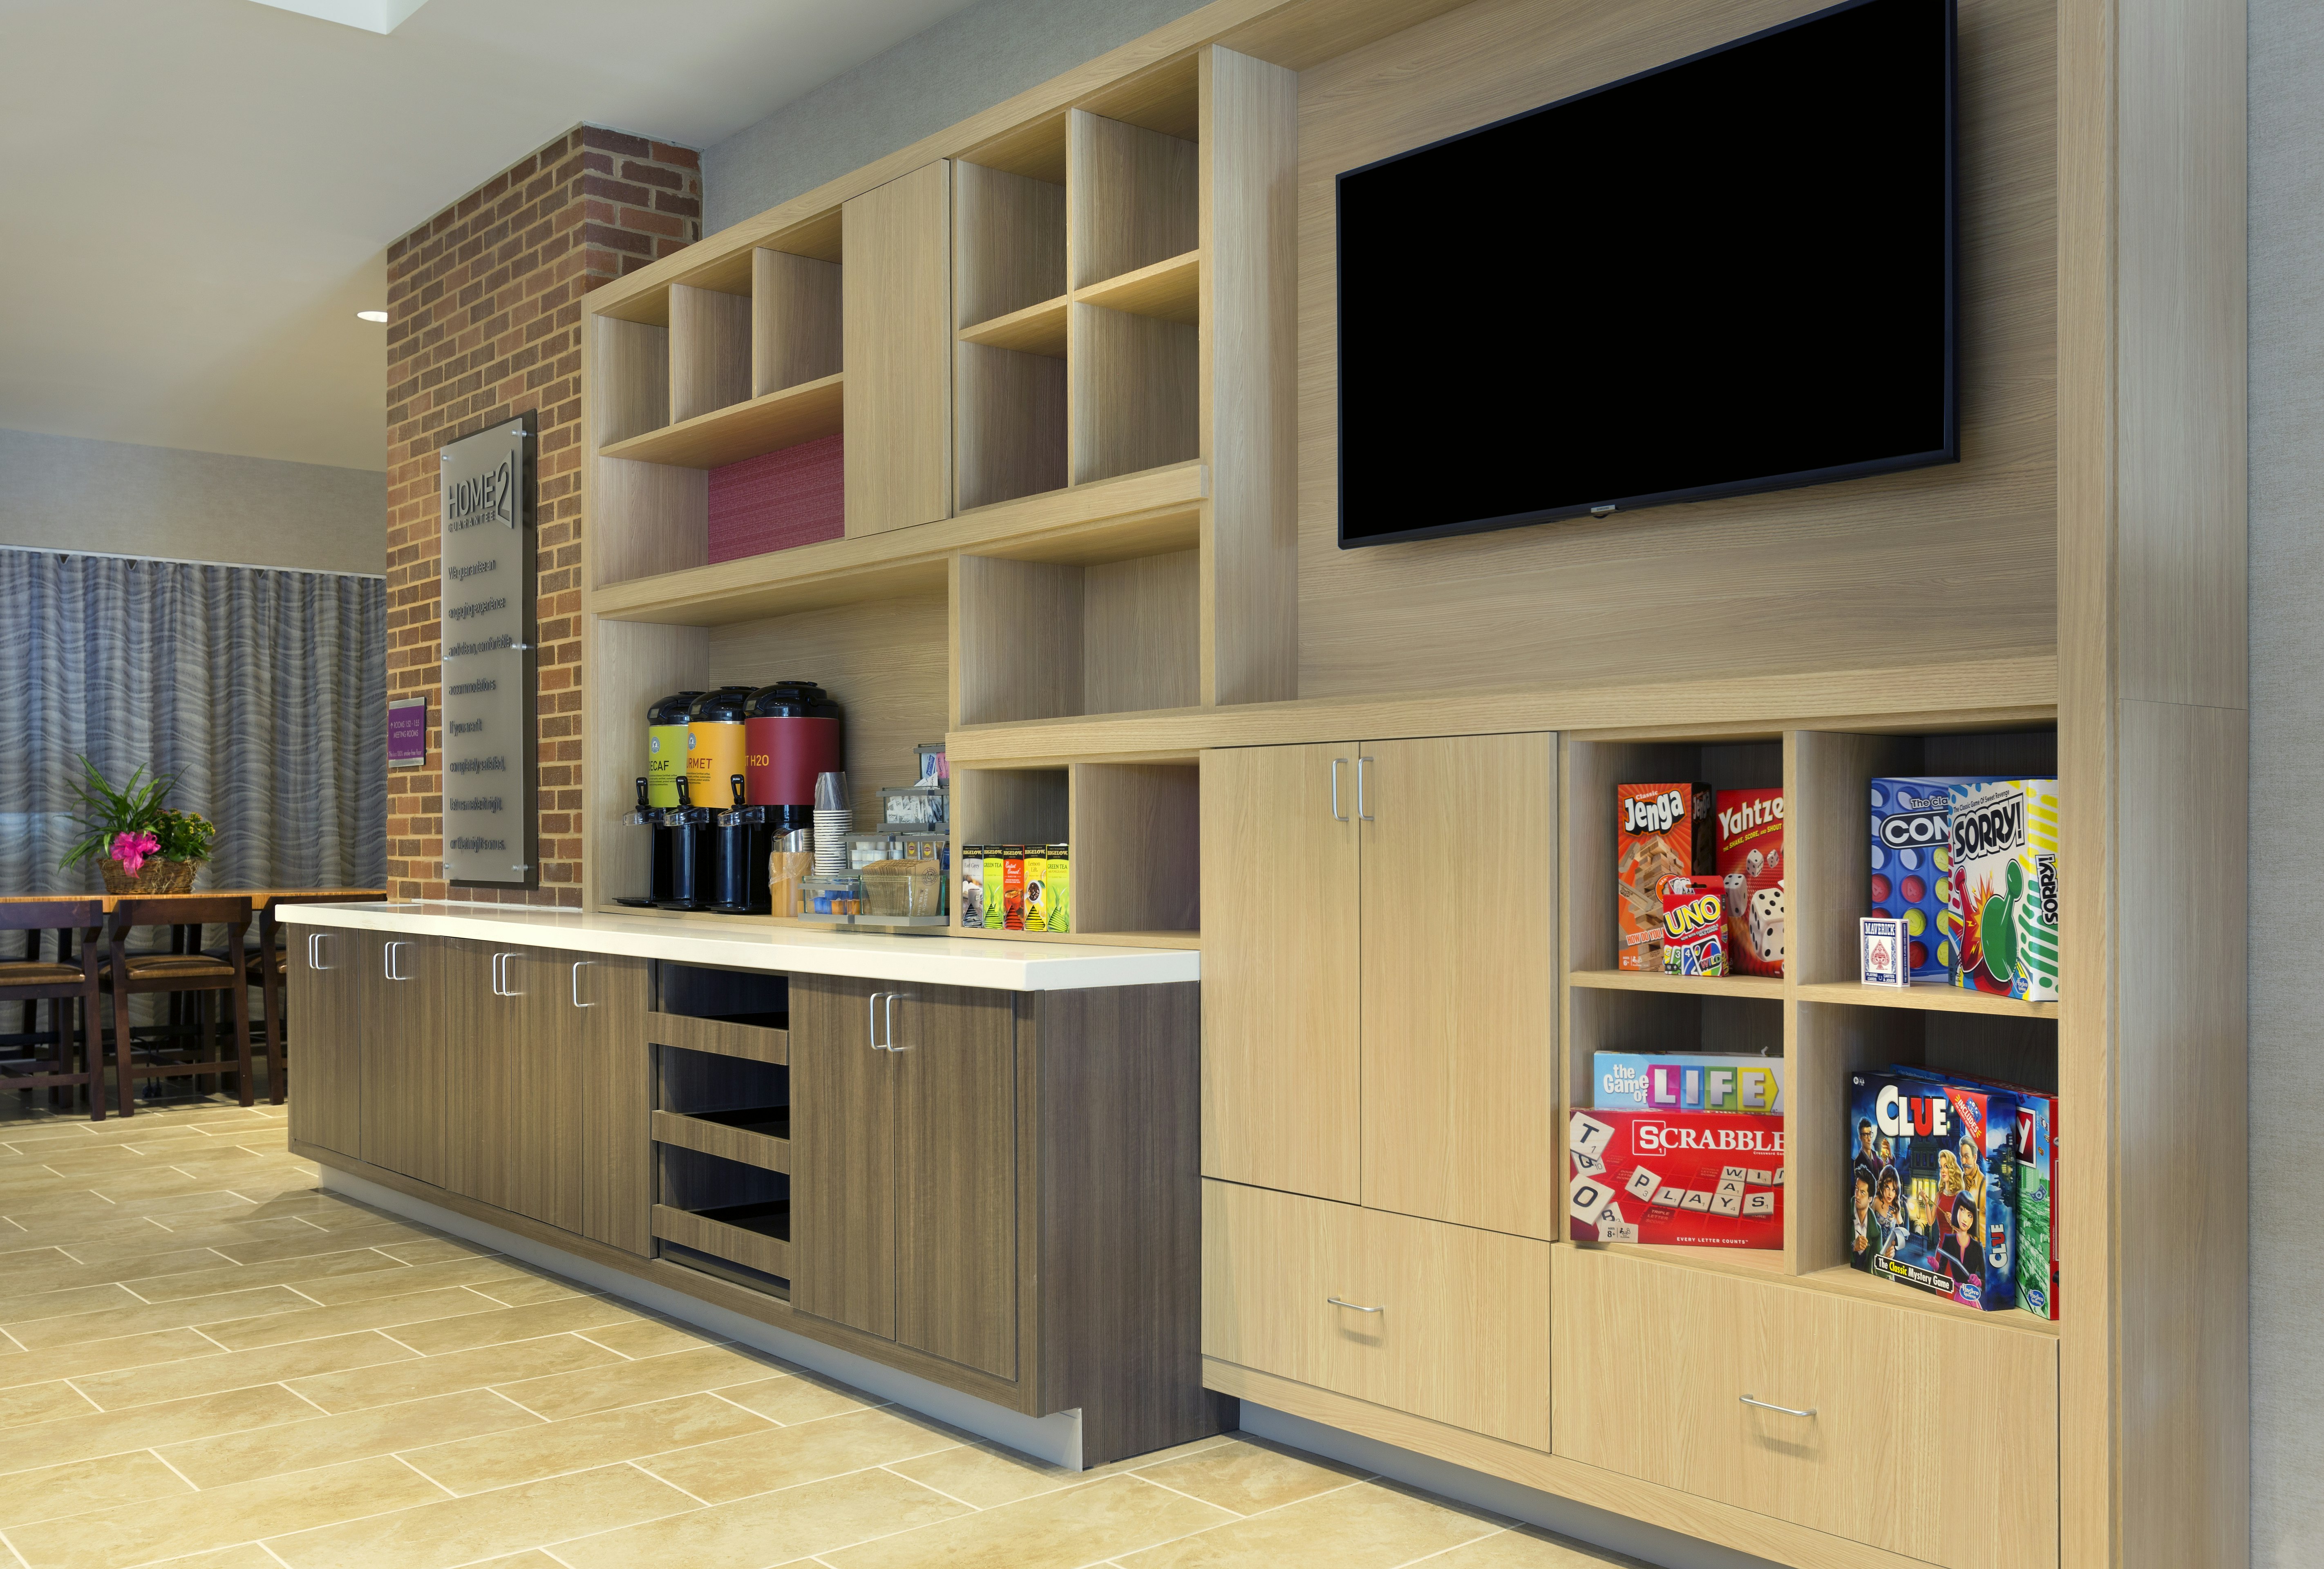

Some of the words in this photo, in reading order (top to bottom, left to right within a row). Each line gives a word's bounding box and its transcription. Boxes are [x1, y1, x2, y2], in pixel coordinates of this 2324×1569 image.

[449, 470, 495, 519] HOME
[448, 511, 494, 532] GUARANTEE
[449, 566, 457, 580] We
[458, 561, 485, 581] guarantee
[487, 560, 495, 570] an
[449, 602, 474, 620] engaging
[474, 597, 505, 615] experience
[449, 643, 460, 657] and
[454, 722, 464, 737] you
[450, 758, 479, 775] completely
[466, 797, 481, 810] make
[1635, 790, 1658, 800] Classic
[1693, 791, 1711, 820] Jenga
[1910, 798, 1930, 809] The
[1959, 802, 1971, 811] Classic
[1995, 790, 2010, 799] Revenge
[1624, 790, 1685, 832] Jenga
[1729, 837, 1744, 849] SHAKE,
[1745, 830, 1760, 841] SCORE,
[1767, 823, 1782, 833] SHOUT
[1955, 800, 2023, 858] SORRY!
[450, 839, 456, 849] or
[1664, 895, 1721, 936] UNO
[1627, 934, 1640, 945] HOW
[1641, 932, 1649, 942] DO
[1649, 928, 1661, 940] YOU
[1865, 922, 1895, 936] MAVERICK
[1700, 954, 1722, 969] WILD
[1613, 1064, 1635, 1079] the
[1603, 1074, 1649, 1094] Game
[1654, 1068, 1765, 1106] LIFE
[1633, 1089, 1648, 1104] of
[1876, 1084, 1947, 1137] CLUE
[1957, 1099, 1979, 1133] INCLUDES
[1580, 1123, 1599, 1144] T
[1573, 1186, 1599, 1208] O
[1988, 1224, 2008, 1268] CLUE
[1878, 1258, 1888, 1270] The
[1889, 1261, 1907, 1276] Classic
[1908, 1267, 1932, 1285] Mystery
[1933, 1275, 1950, 1290] Game
[1960, 1284, 1979, 1296] Hasbro
[2029, 1289, 2044, 1302] Hasbro
